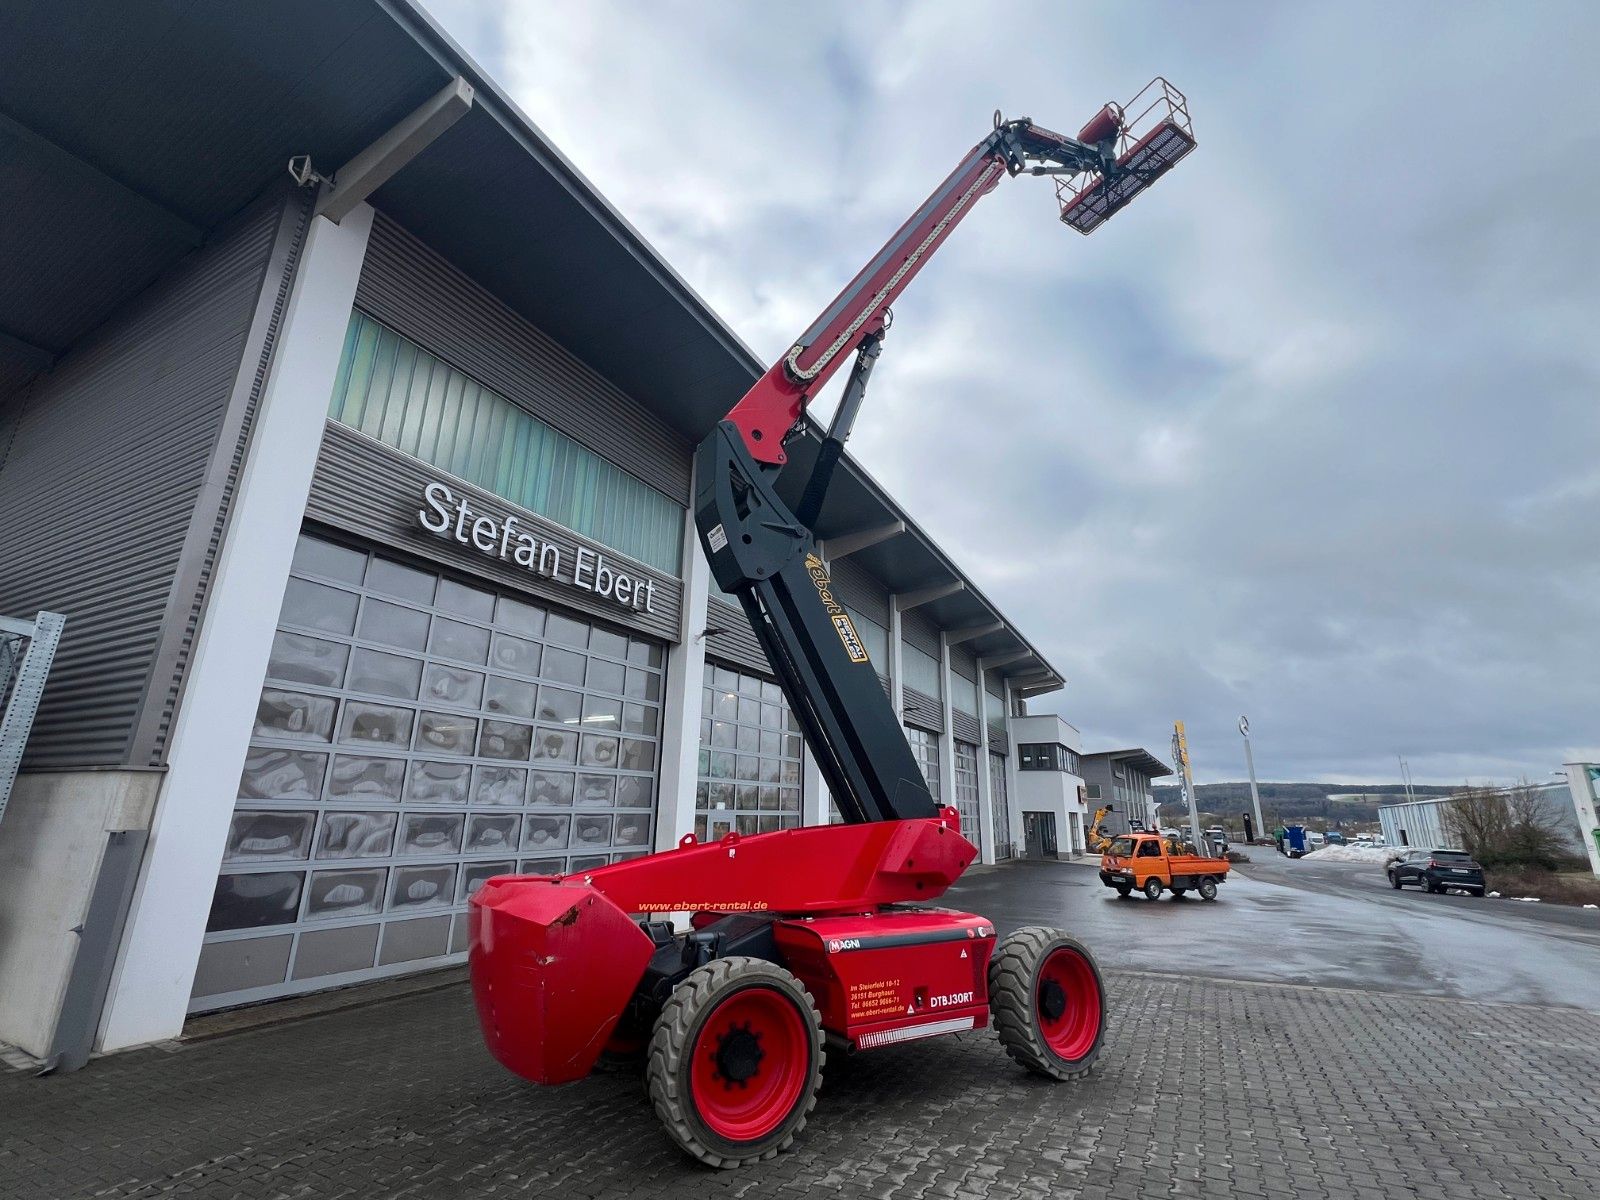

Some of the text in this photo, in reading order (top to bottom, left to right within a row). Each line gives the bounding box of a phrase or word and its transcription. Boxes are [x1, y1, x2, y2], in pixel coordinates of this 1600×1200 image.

[419, 482, 656, 613] Stefan Ebert
[840, 618, 863, 658] RENTAL
[638, 900, 768, 911] www.ebert-rental.de
[829, 939, 861, 953] MAGNI
[886, 979, 900, 988] 10-12
[867, 989, 895, 999] Burghaun
[930, 991, 974, 1008] DTBJ30RT
